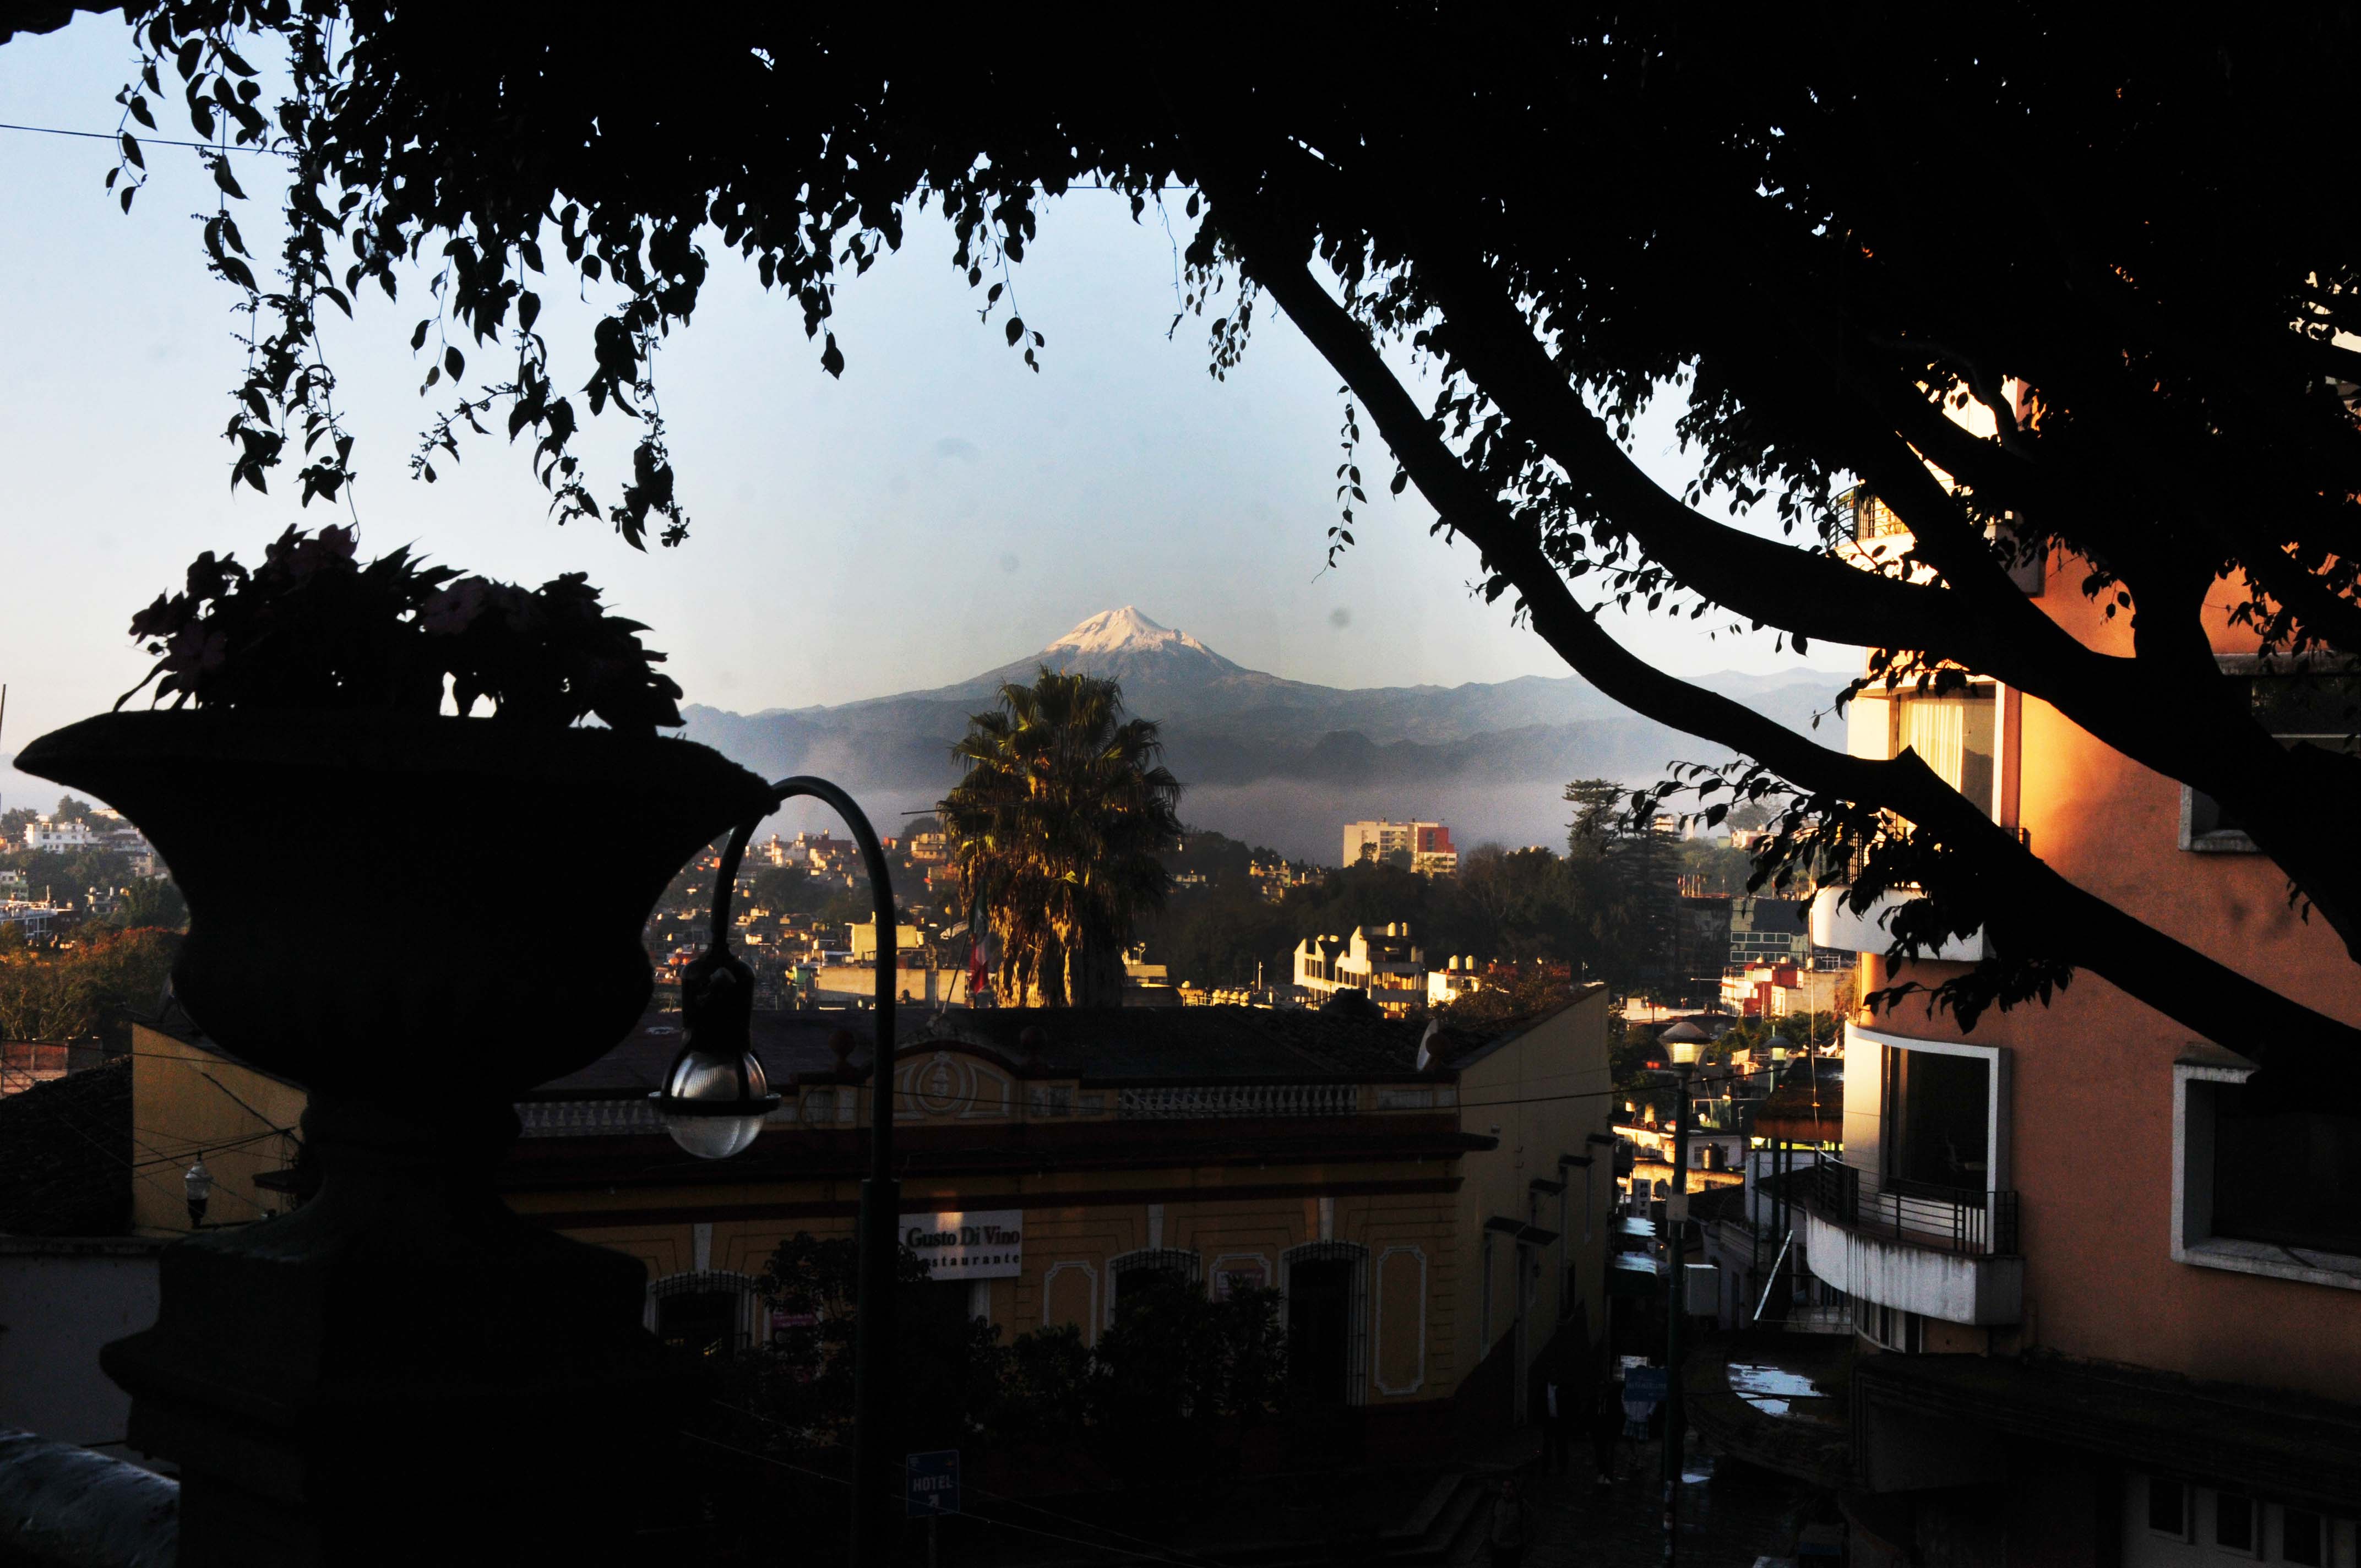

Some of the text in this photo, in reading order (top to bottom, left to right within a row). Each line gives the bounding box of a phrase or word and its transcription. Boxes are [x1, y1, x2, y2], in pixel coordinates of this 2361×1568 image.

[1640, 1182, 1648, 1216] HOTE
[906, 1225, 1020, 1247] Gusto Di Vino
[923, 1253, 1020, 1267] estaurante
[912, 1475, 953, 1493] HOTEL
